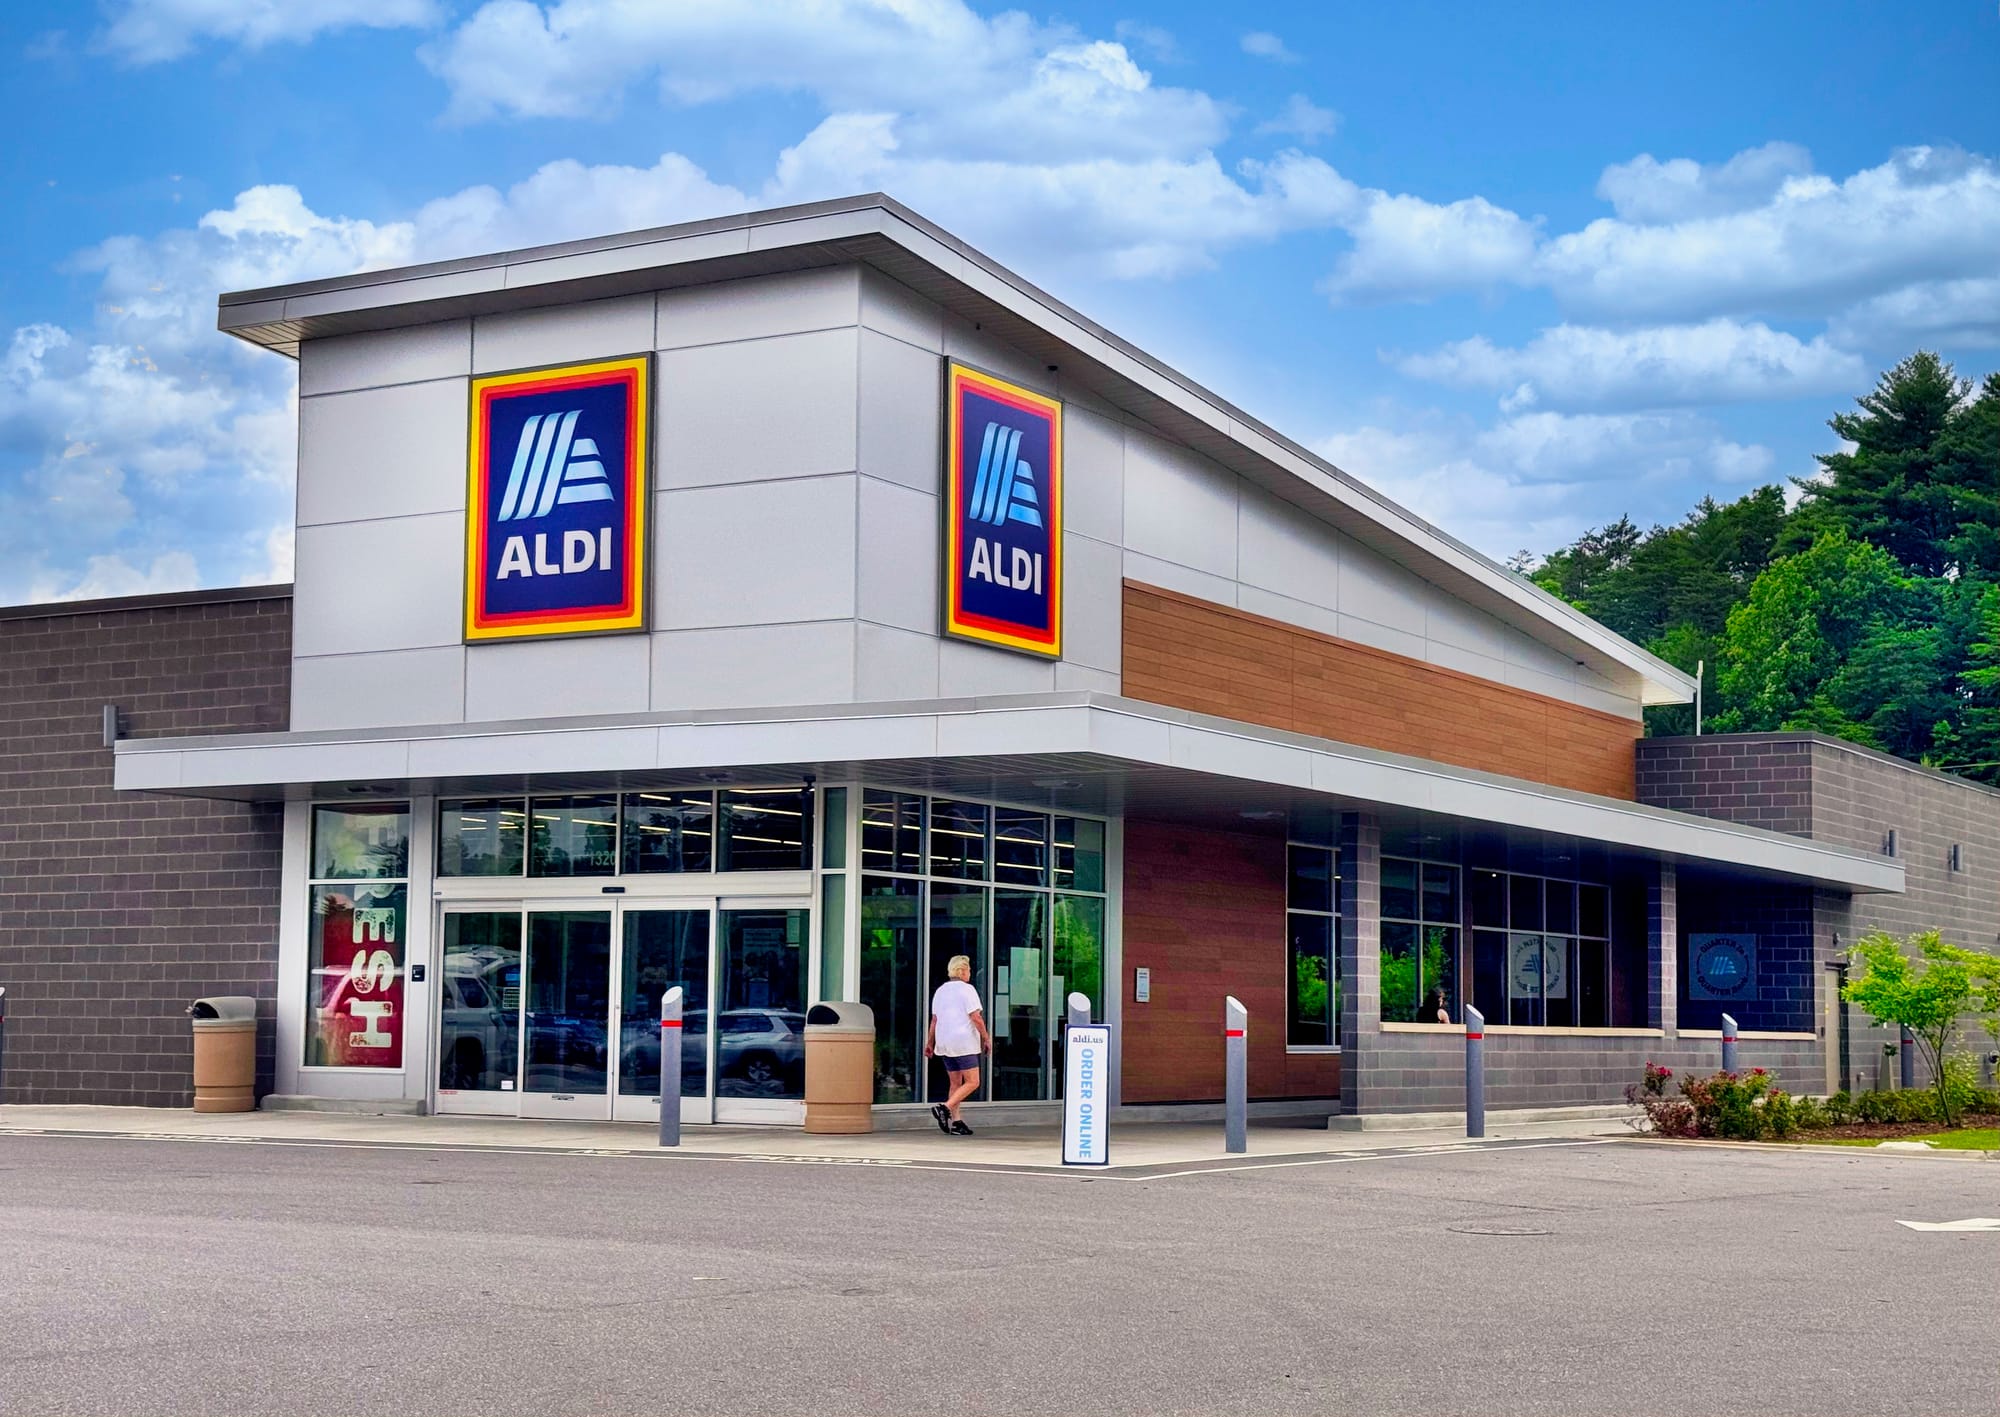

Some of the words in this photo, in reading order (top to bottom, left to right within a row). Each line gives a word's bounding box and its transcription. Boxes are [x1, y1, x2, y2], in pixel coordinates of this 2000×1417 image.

[496, 527, 612, 580] ALDI
[968, 537, 1042, 596] ALDI
[348, 813, 398, 1048] FRESH
[1072, 1034, 1104, 1044] aldi.us
[1080, 1048, 1094, 1099] ORDER
[1078, 1103, 1093, 1159] ONLINE
